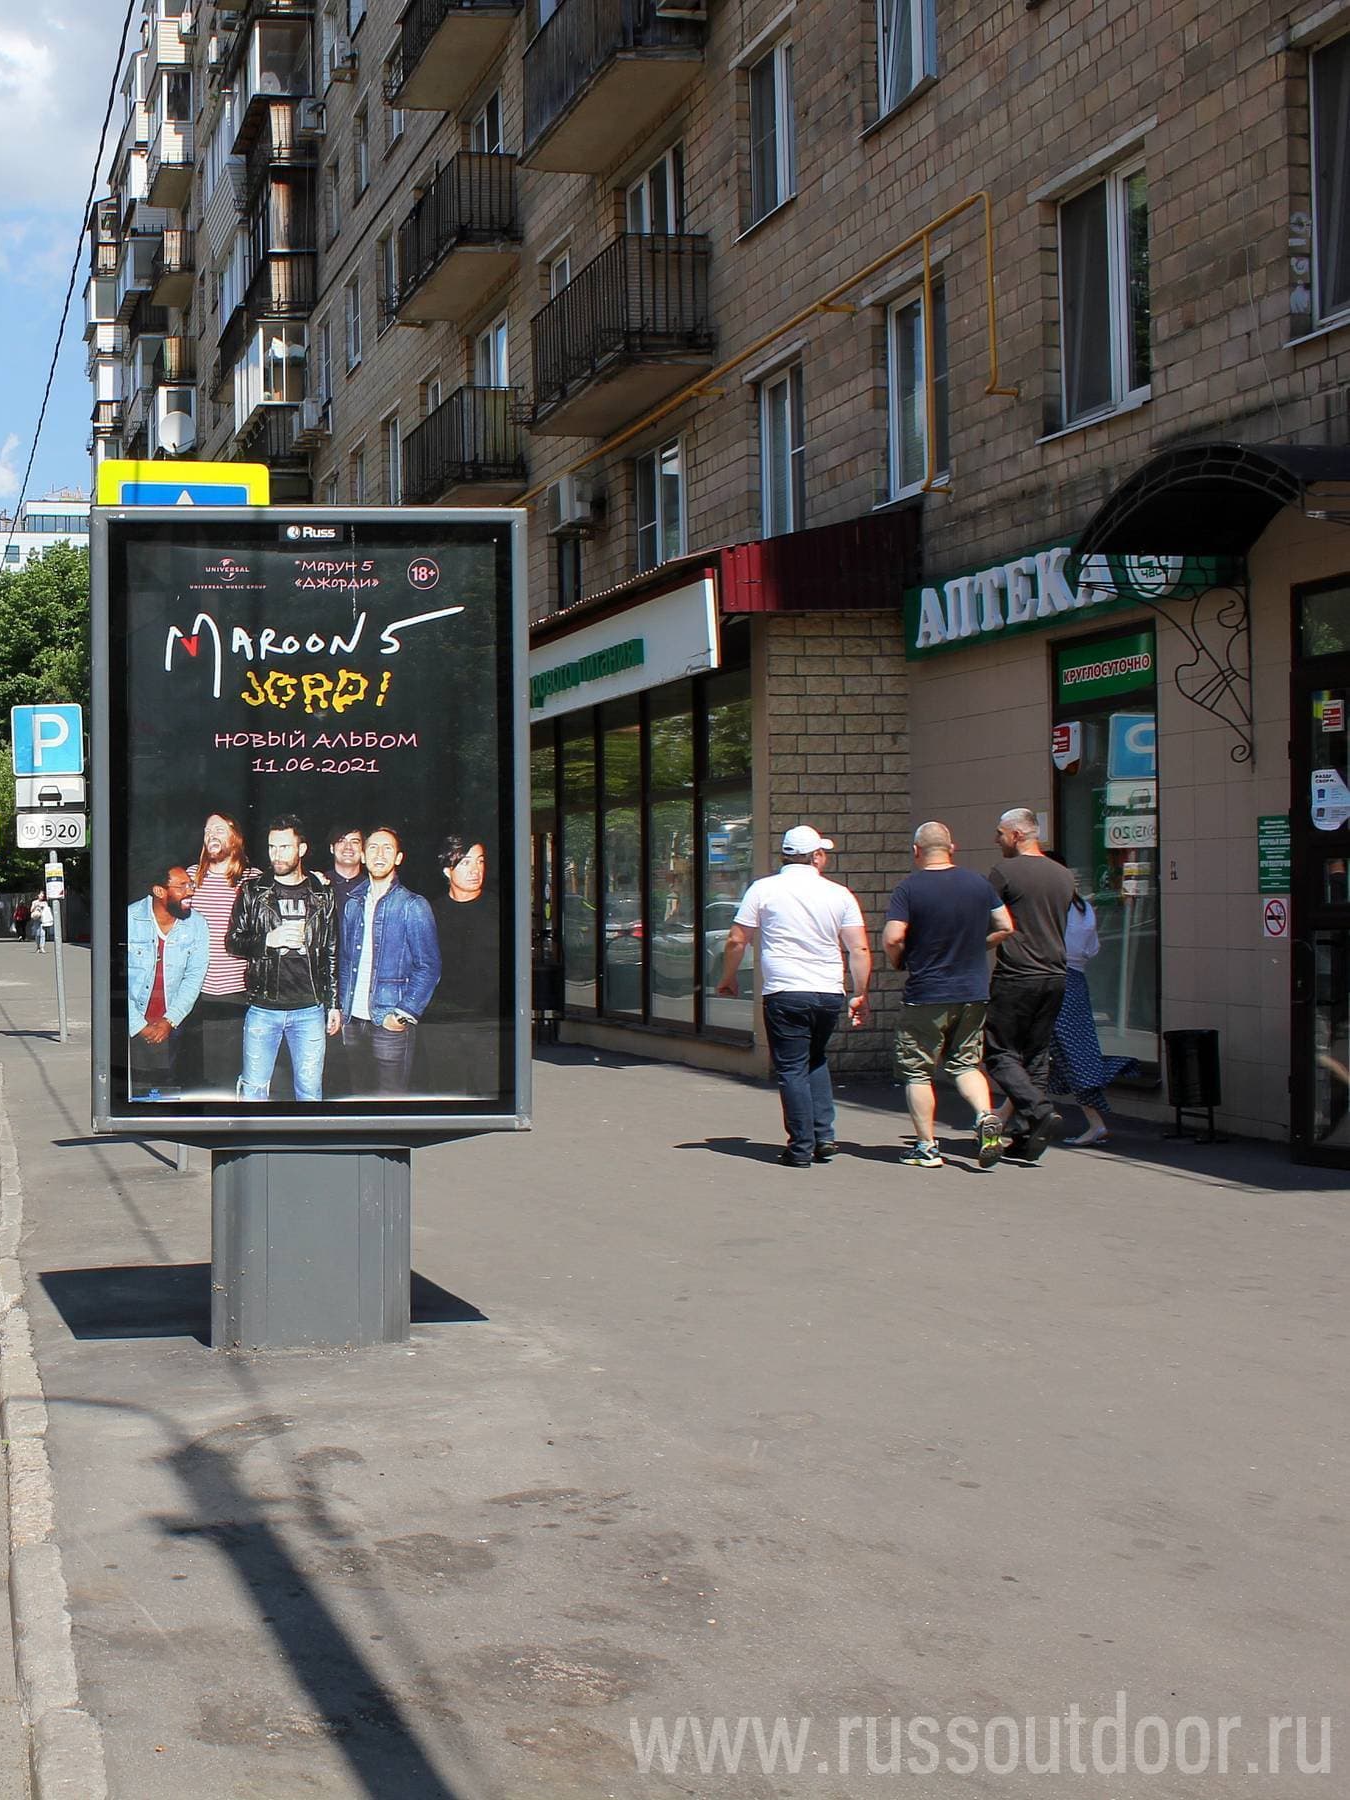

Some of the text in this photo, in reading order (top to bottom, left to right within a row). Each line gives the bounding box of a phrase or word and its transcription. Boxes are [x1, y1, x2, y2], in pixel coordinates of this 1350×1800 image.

[302, 526, 336, 538] Russ
[361, 560, 374, 571] 5
[411, 566, 436, 581] 18+
[294, 577, 380, 593] «Джорди»
[915, 546, 1118, 649] АПТЕКА
[165, 605, 466, 699] MAROON 5
[1062, 653, 1151, 685] КРУГЛОСУТОЧНО
[31, 713, 69, 767] P
[214, 730, 418, 750] НОВЫЙ АЛЬБОМ
[252, 756, 380, 774] 11.06.2021
[25, 823, 78, 838] 10 15 20
